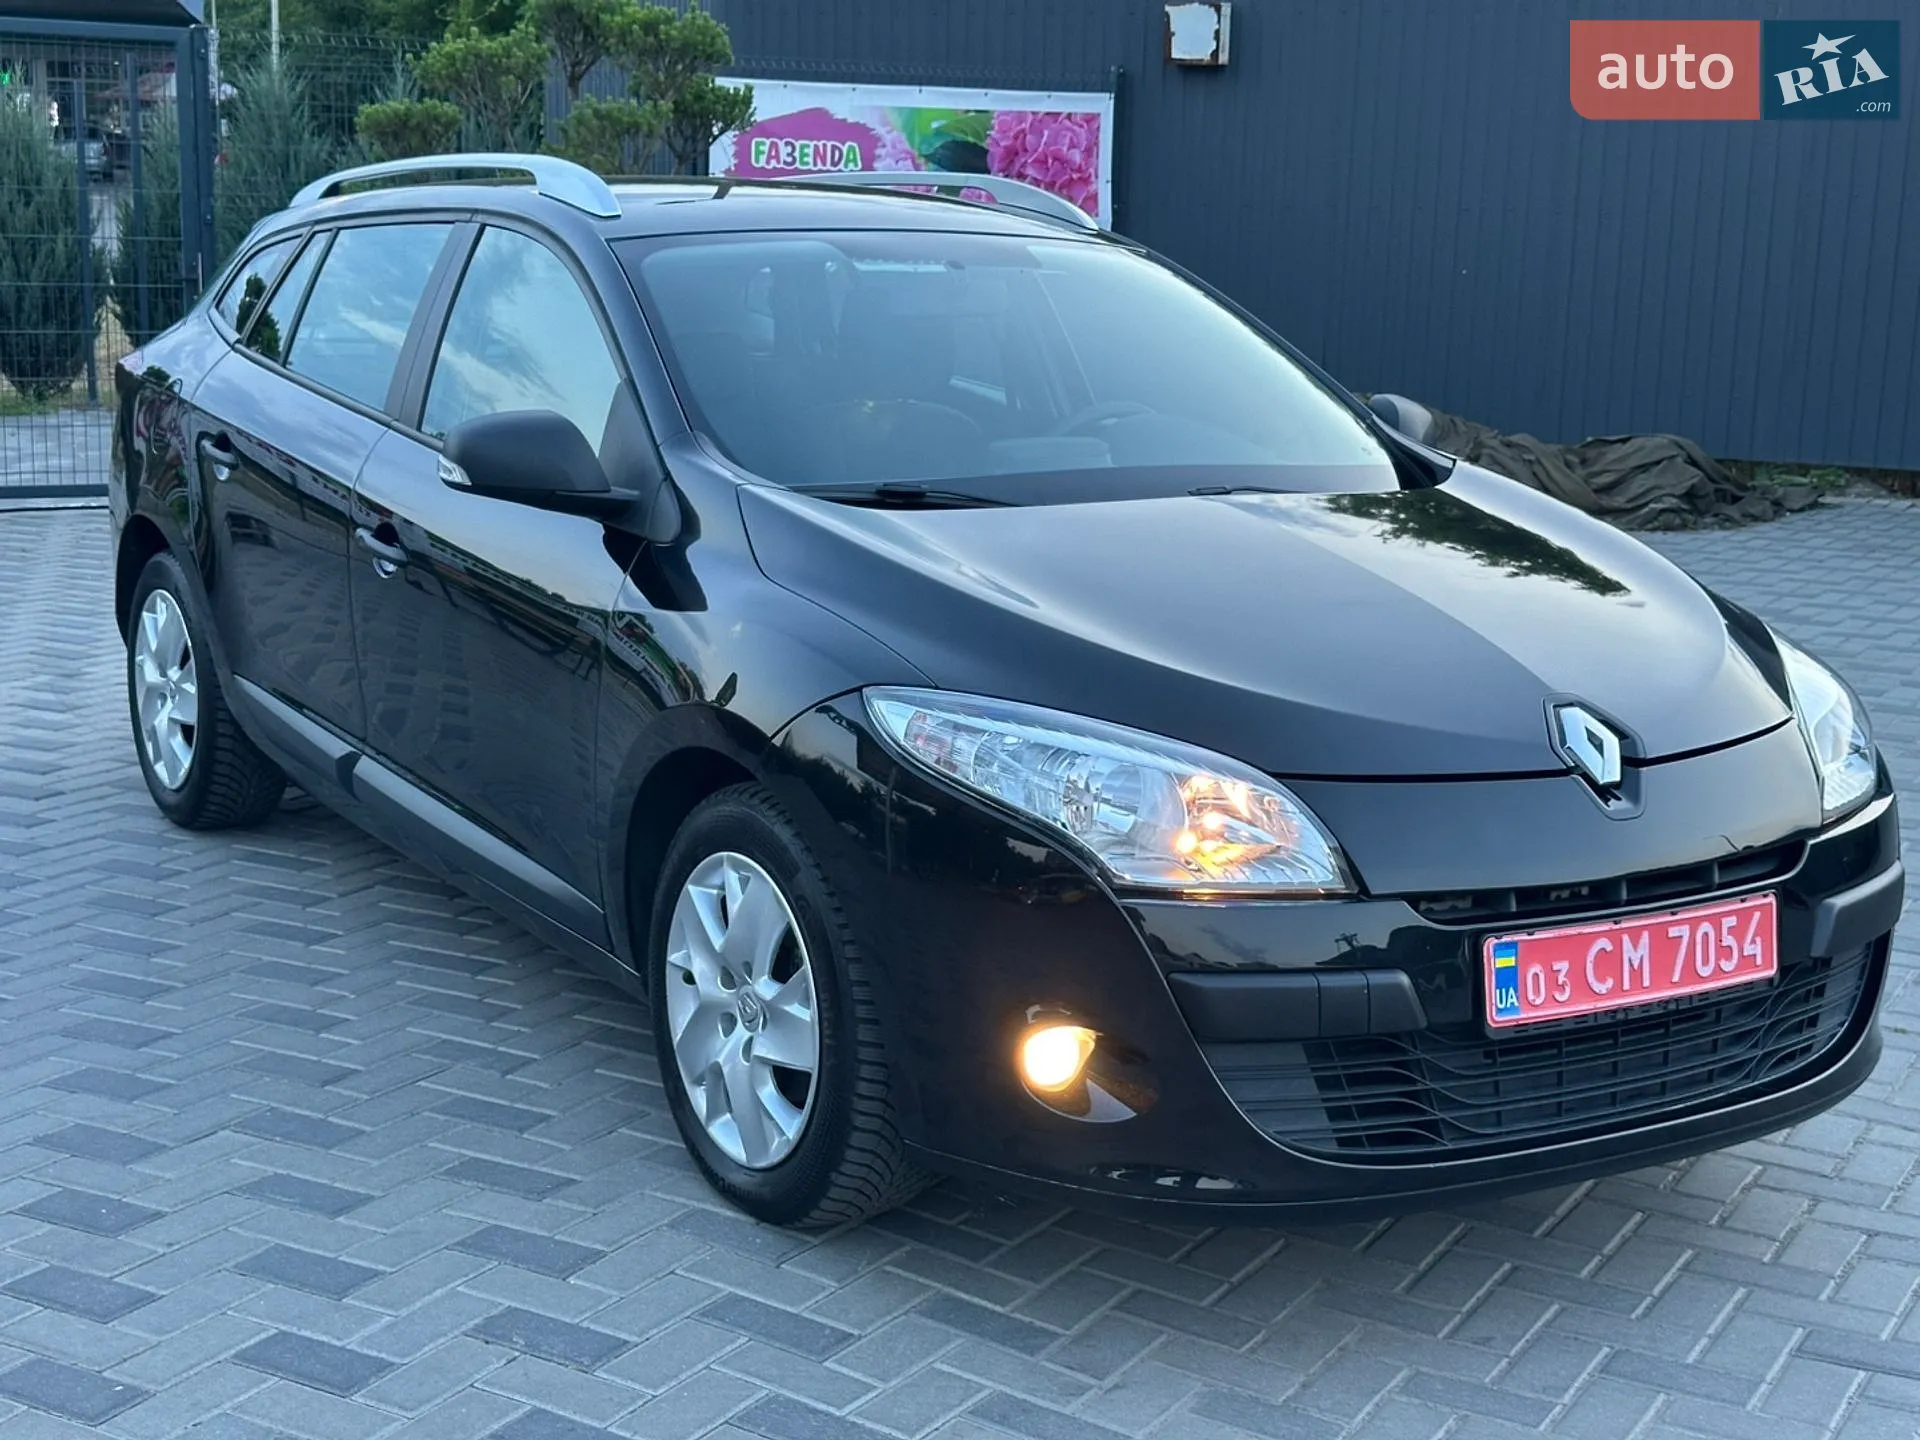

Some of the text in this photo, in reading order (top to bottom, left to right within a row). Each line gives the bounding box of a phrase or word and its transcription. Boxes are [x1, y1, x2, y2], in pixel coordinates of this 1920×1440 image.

[1525, 910, 1763, 1006] 03 CM 7054
[1495, 986, 1519, 1009] UA
